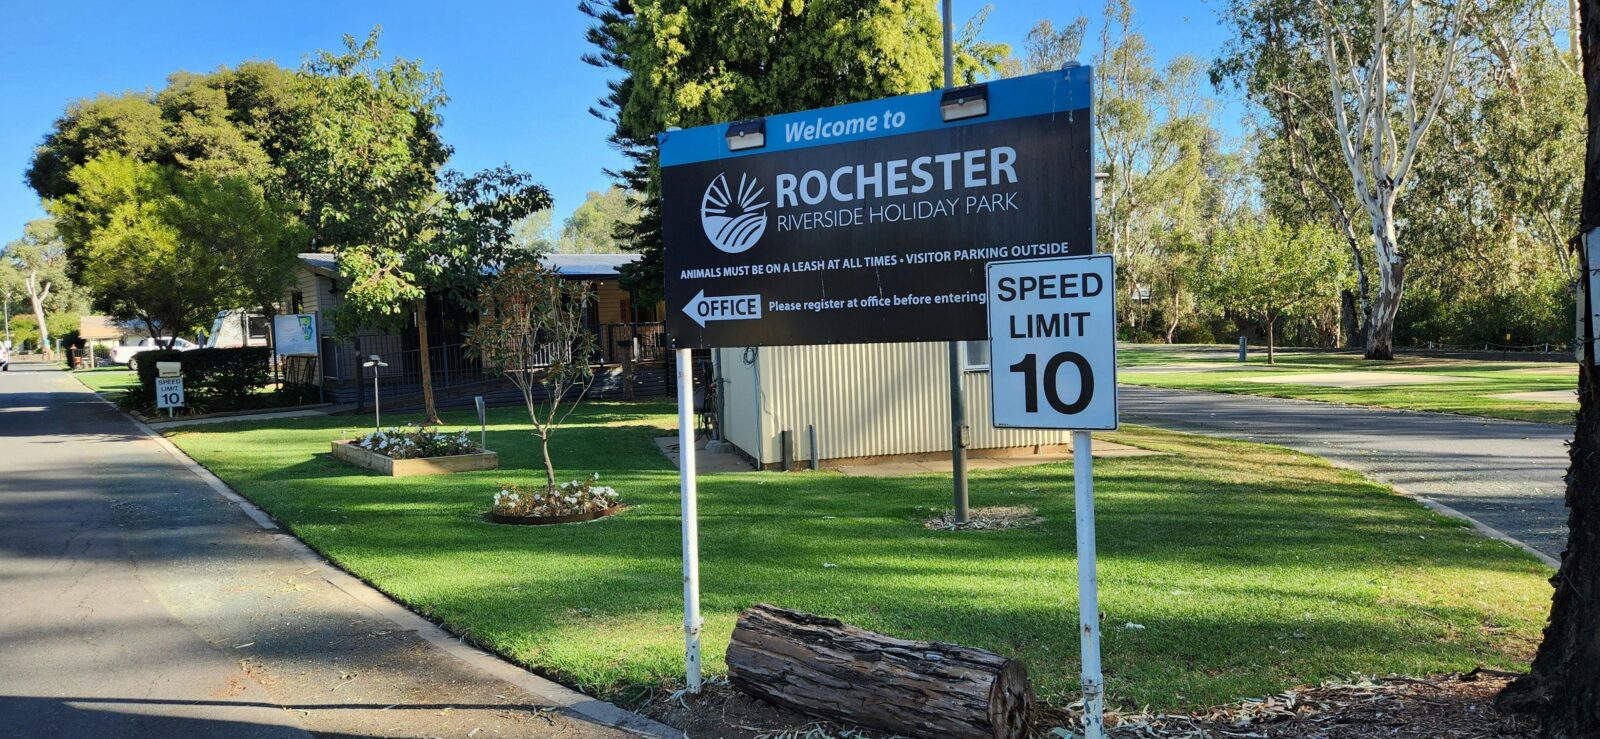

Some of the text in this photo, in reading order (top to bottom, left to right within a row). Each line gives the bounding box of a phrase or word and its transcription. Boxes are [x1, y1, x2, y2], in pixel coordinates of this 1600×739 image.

[785, 109, 906, 143] Welcome to
[776, 146, 1019, 208] ROCHESTER
[777, 191, 1019, 232] RIVERSIDE HOLIDAY PARK
[680, 242, 1069, 280] ANIMALS MUST BE ON A LEASH AT ALL TIMES VISITOR PARKING OUTSIDE
[769, 291, 986, 313] Please register at office before entering
[997, 272, 1104, 302] SPEED
[697, 298, 757, 317] OFFICE
[1009, 311, 1091, 340] LIMIT
[161, 393, 180, 405] 10
[1008, 351, 1095, 416] 10
